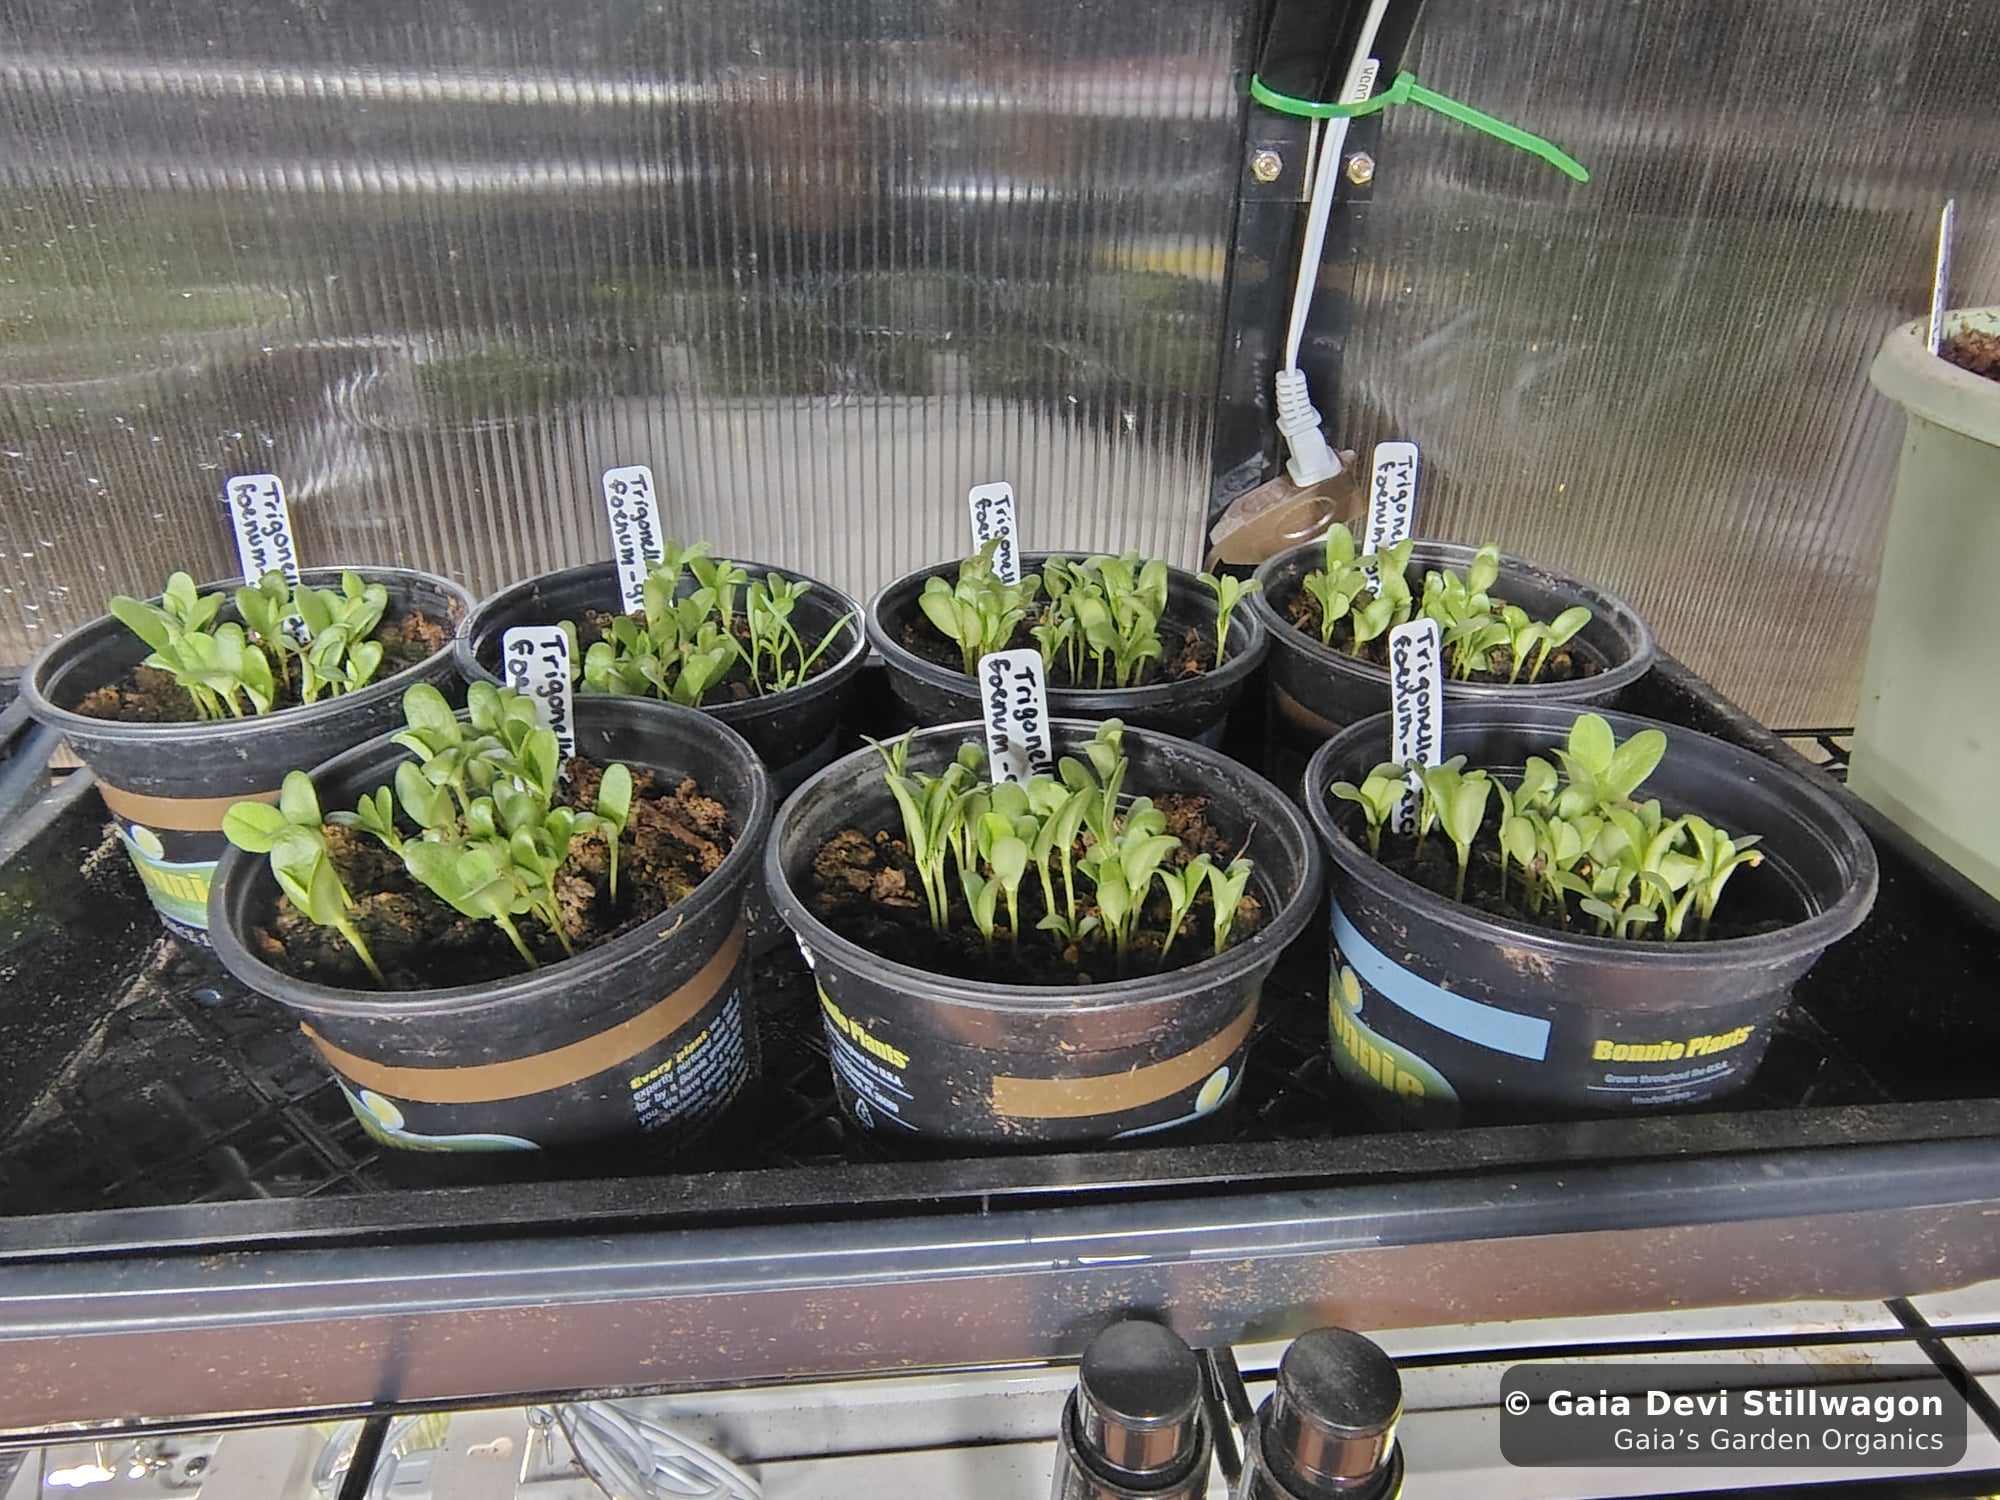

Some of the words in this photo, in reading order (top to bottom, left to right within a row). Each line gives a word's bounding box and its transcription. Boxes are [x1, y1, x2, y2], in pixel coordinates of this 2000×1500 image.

[234, 483, 268, 587] foenum-
[629, 473, 661, 561] Trigonell
[994, 494, 1016, 584] Trigonell
[1012, 666, 1055, 776] Trigonell
[629, 1057, 673, 1090] Every
[676, 1029, 709, 1064] plant
[1331, 997, 1426, 1103] onnie
[1592, 1039, 1686, 1062] Bonnie
